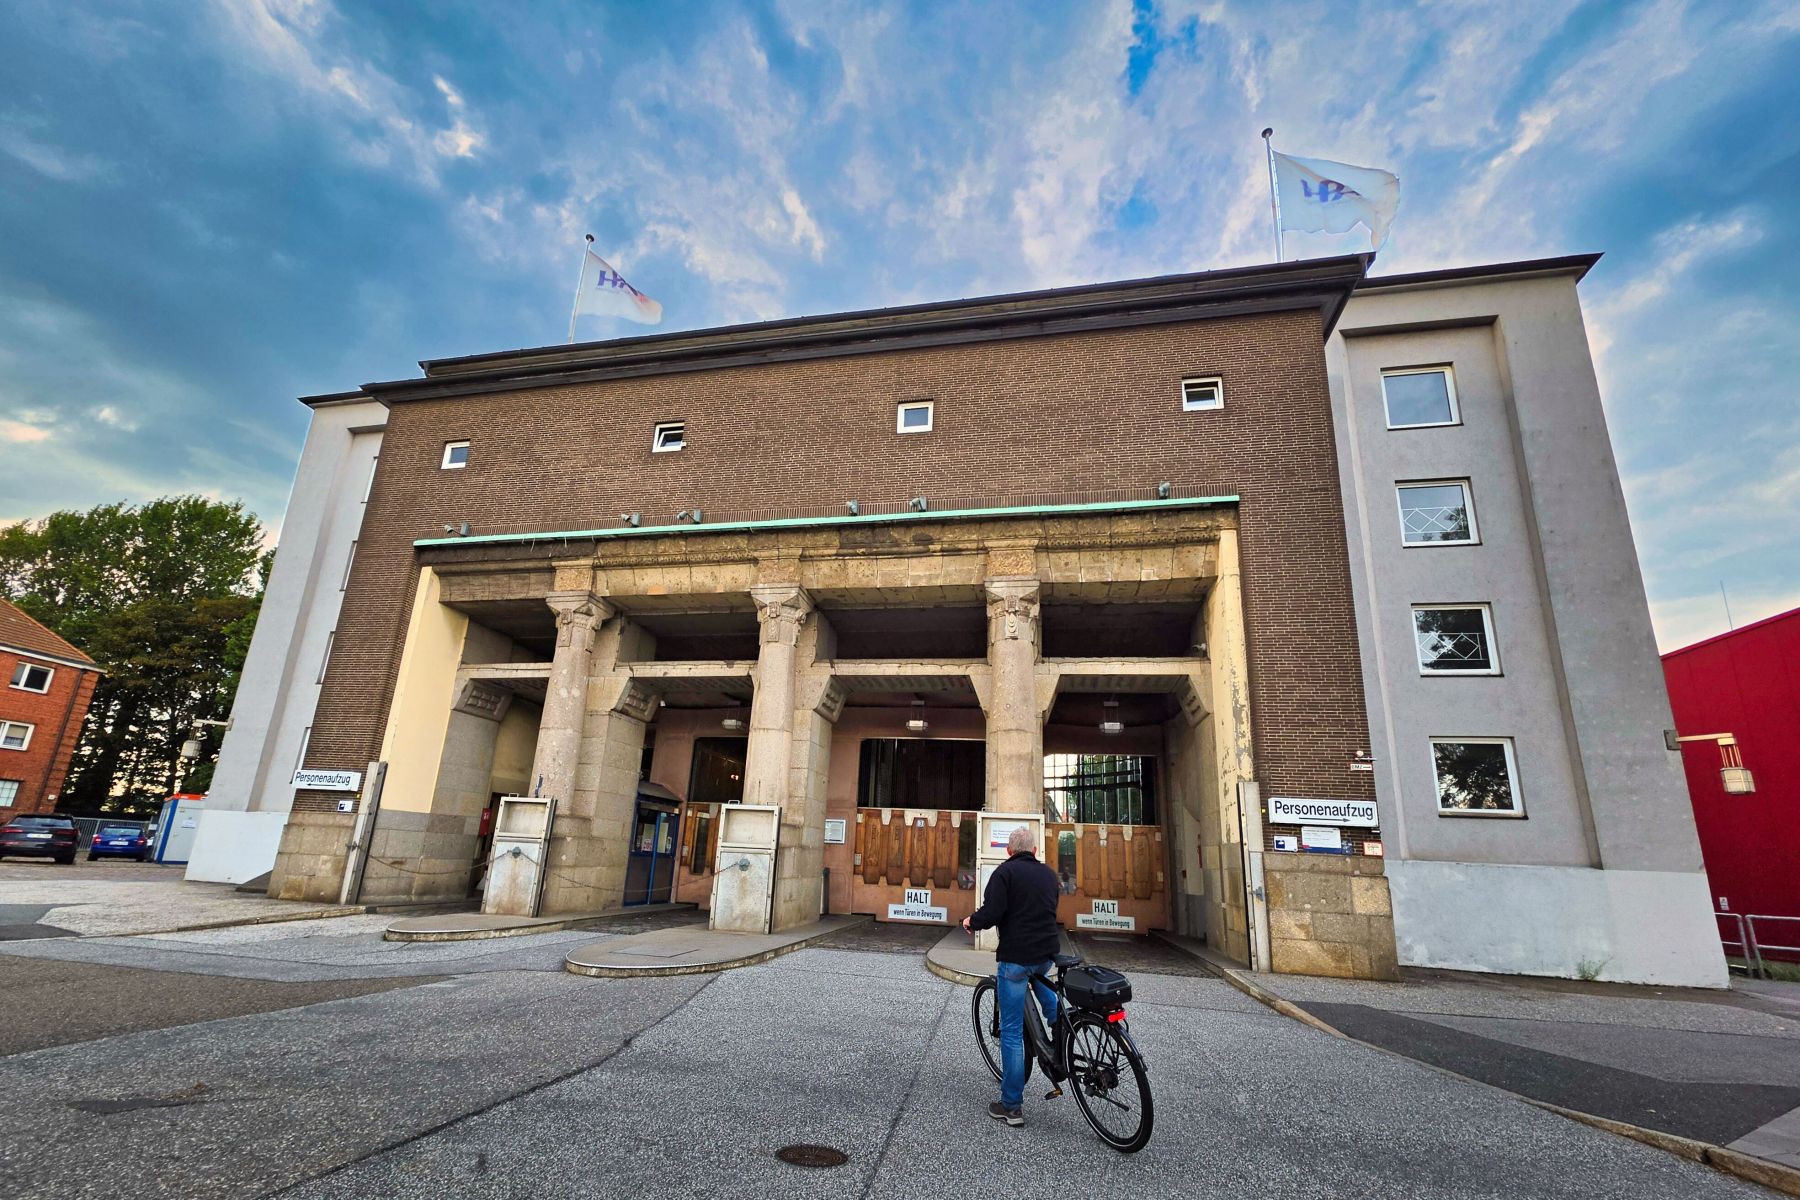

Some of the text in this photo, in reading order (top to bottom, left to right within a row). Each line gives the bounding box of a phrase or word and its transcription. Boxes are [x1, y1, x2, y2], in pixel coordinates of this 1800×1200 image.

[295, 772, 351, 786] Personenaufzug
[1274, 800, 1374, 820] Personenaufzug
[907, 891, 929, 904] HALT
[1094, 902, 1116, 913] HALT
[905, 908, 916, 916] Türen
[921, 910, 942, 920] Bewegung
[1109, 919, 1130, 929] Bewegung
